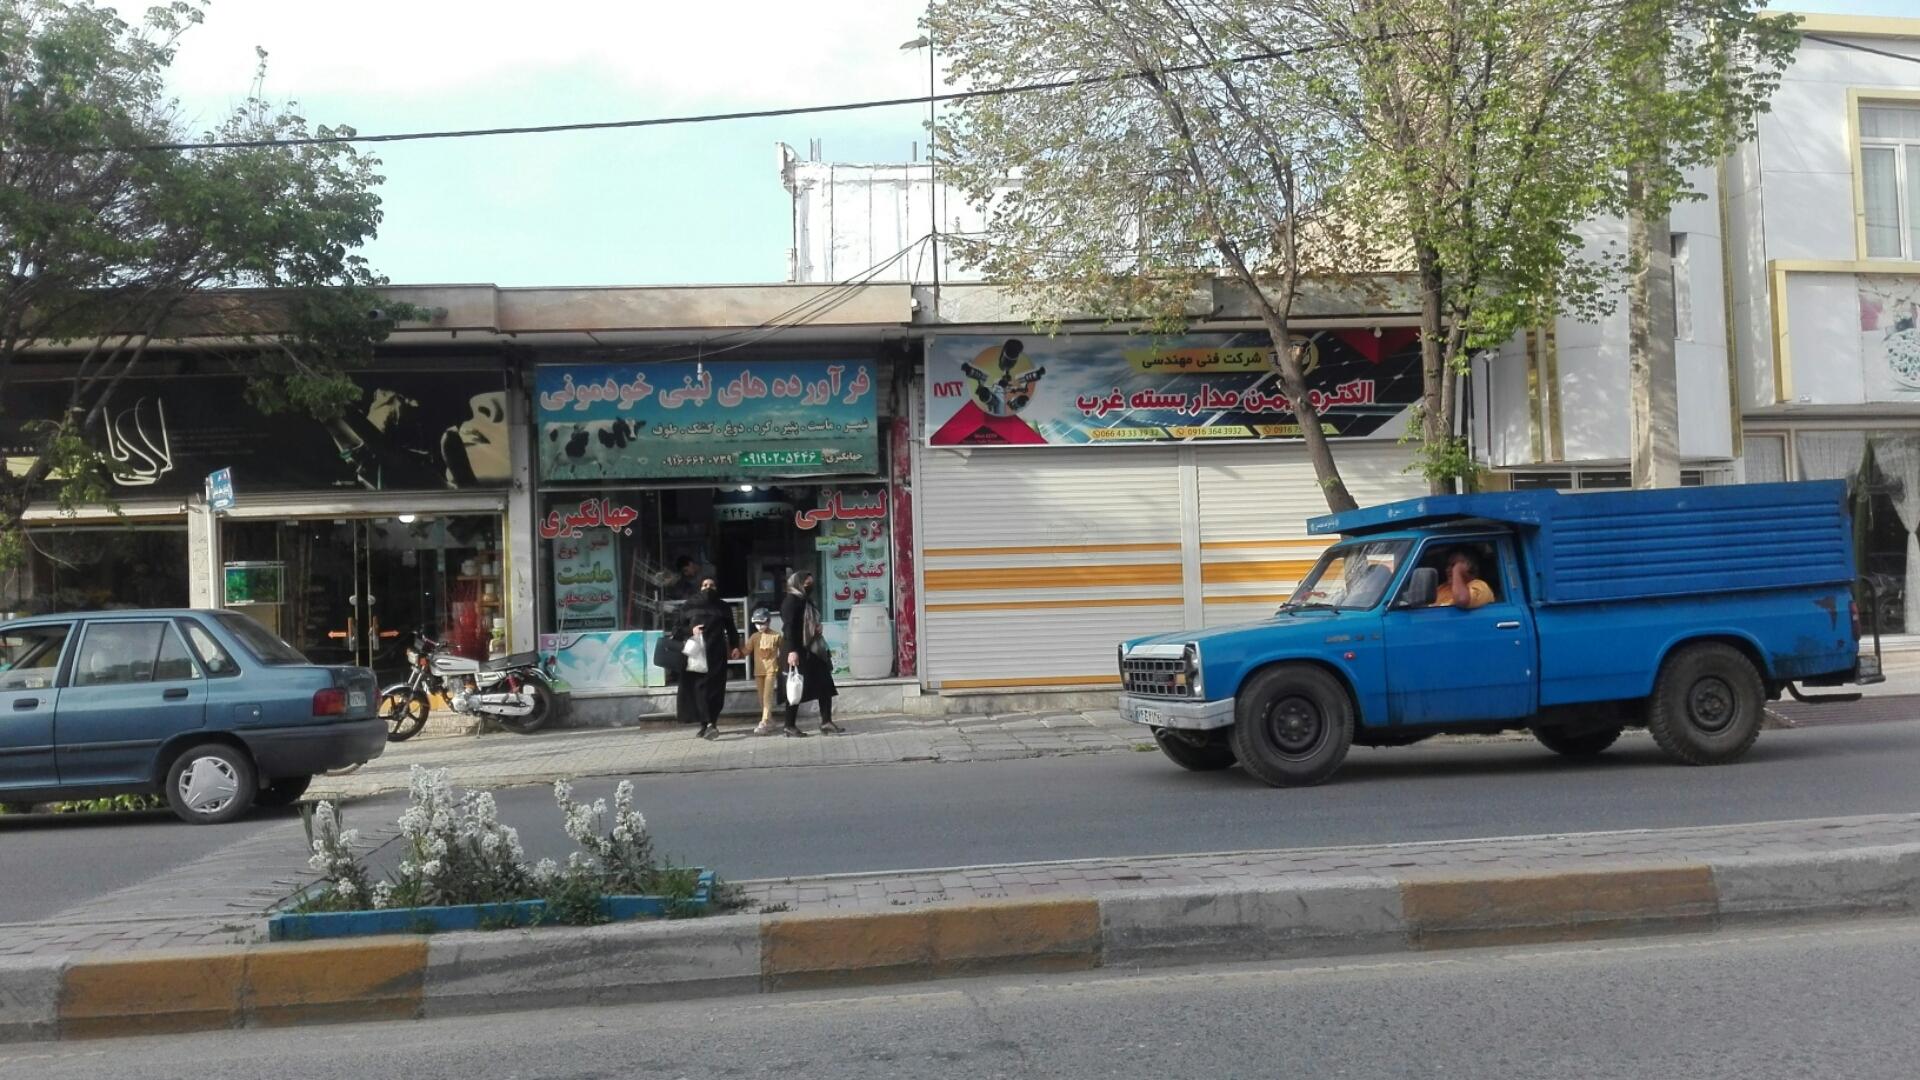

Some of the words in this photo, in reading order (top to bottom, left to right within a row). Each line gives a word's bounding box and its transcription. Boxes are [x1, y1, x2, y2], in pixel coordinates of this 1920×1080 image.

[1142, 353, 1192, 369] مهندسی
[1197, 352, 1220, 367] فنی
[1223, 352, 1262, 367] شرکت
[540, 372, 654, 411] خودمونی
[659, 370, 712, 409] لبنی
[718, 369, 768, 407] های
[1188, 384, 1239, 417] مدار
[1076, 387, 1125, 418] غرب
[1130, 388, 1188, 415] بسته
[1243, 389, 1293, 415] یمن
[724, 421, 744, 437] دوغ
[753, 420, 772, 436] کره
[806, 419, 834, 432] ماست
[539, 497, 639, 539] جهانگیری
[795, 488, 888, 530] لبنیاتی
[557, 560, 613, 585] ماست
[847, 561, 886, 581] کشک
